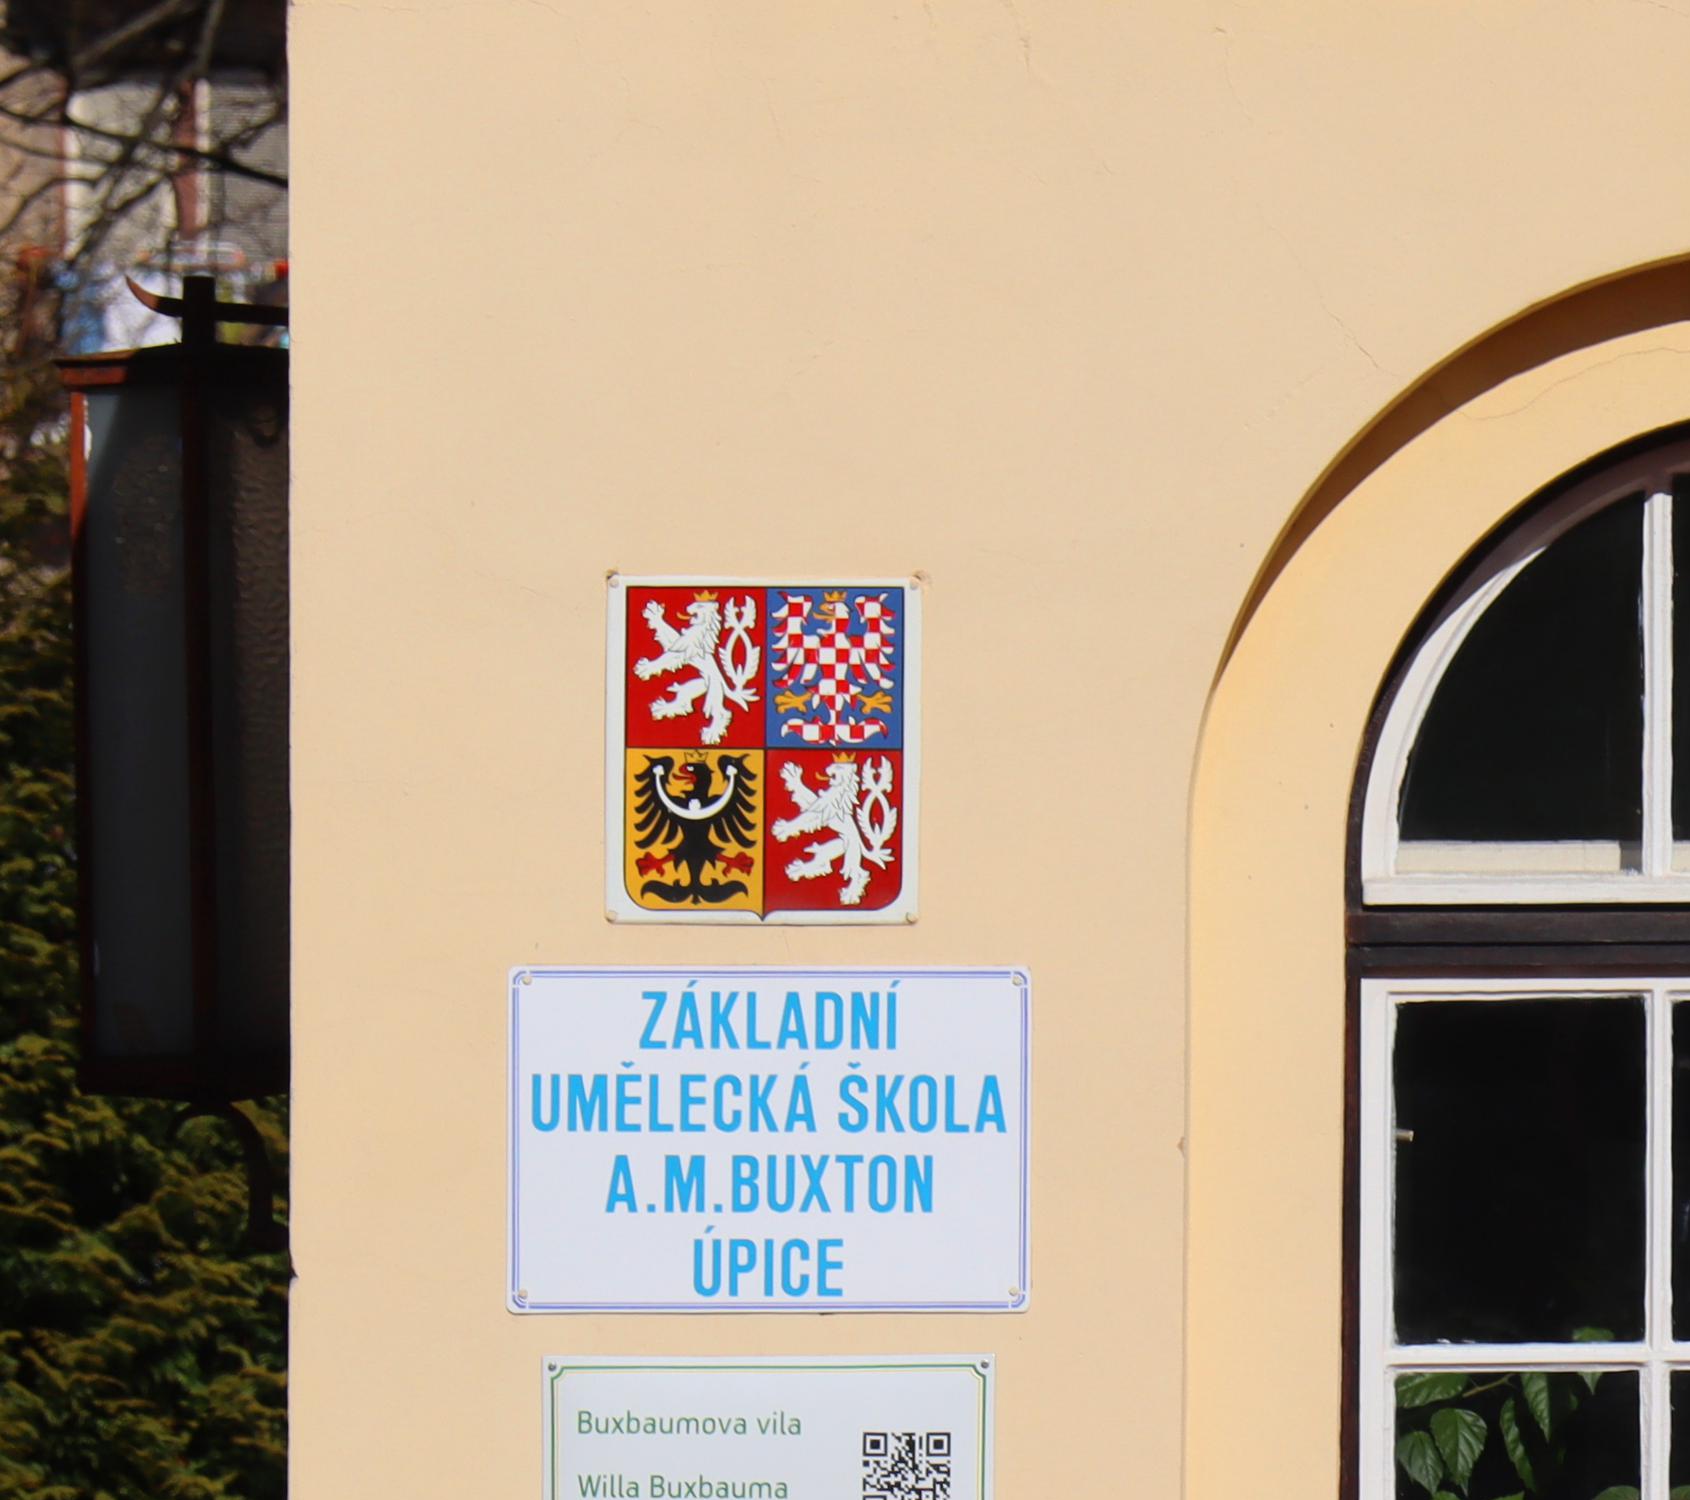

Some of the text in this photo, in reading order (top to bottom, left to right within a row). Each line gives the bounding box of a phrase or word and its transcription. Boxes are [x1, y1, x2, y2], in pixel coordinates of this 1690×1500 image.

[639, 980, 901, 1050] ZÁKLADNÍ
[532, 1061, 1007, 1133] UMĚLECKÁ ŠKOLA
[605, 1154, 934, 1214] A.M.BUXTON
[693, 1225, 844, 1297] ÚPICE
[577, 1410, 802, 1436] Buxbaumova vila
[577, 1475, 788, 1499] Willa Buxbauma
